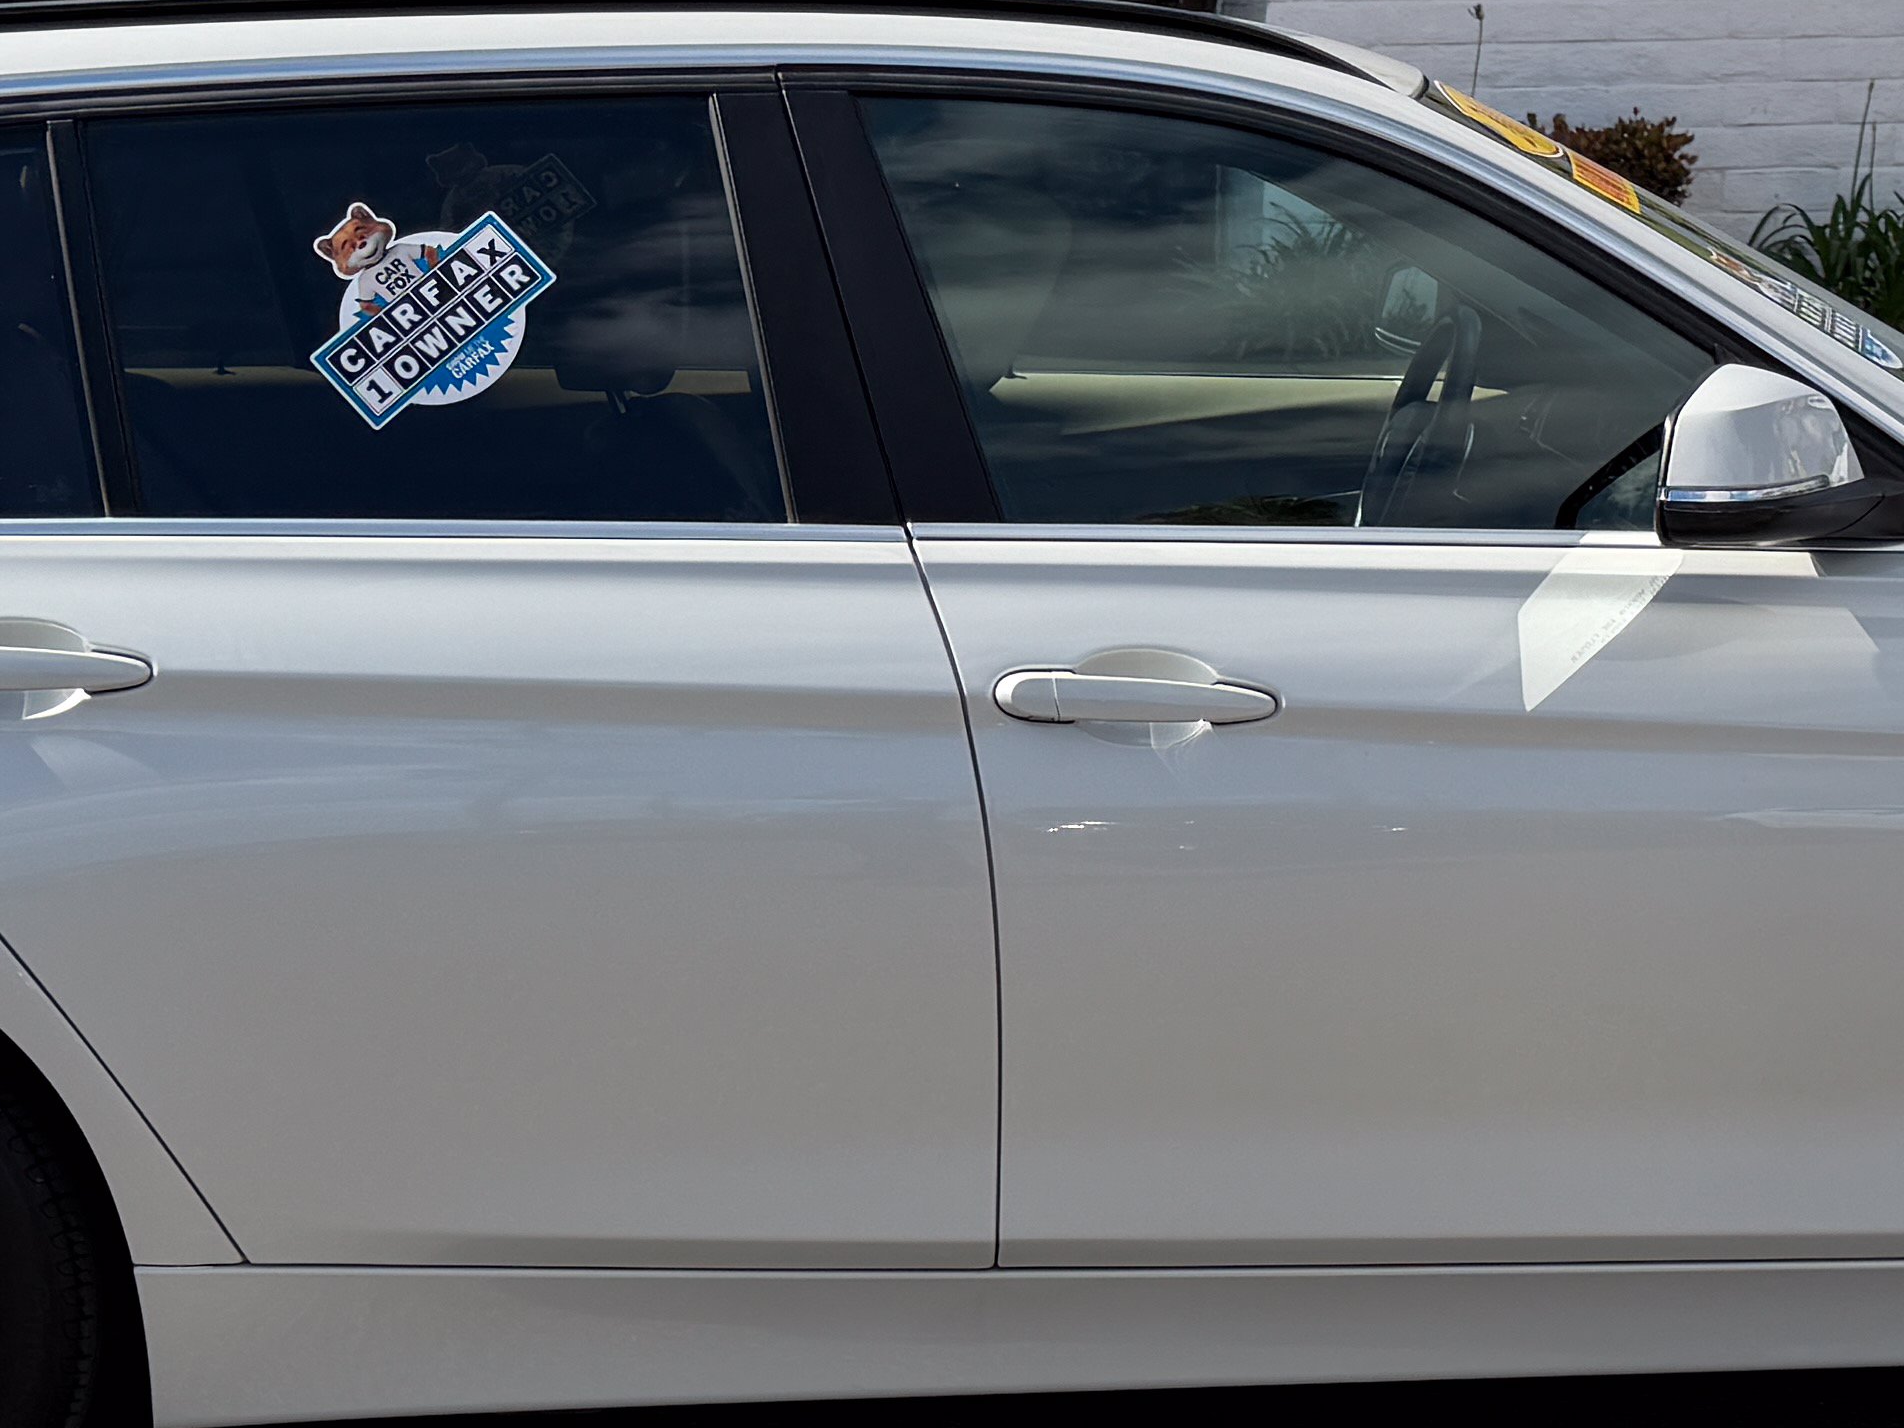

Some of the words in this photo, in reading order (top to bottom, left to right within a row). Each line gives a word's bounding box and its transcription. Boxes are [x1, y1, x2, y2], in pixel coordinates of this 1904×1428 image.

[375, 258, 407, 285] CAR
[386, 268, 416, 296] FOX
[340, 238, 507, 372] CARFAX
[366, 379, 393, 404] 1
[394, 263, 530, 379] OWNER
[451, 340, 495, 379] CARFAX
